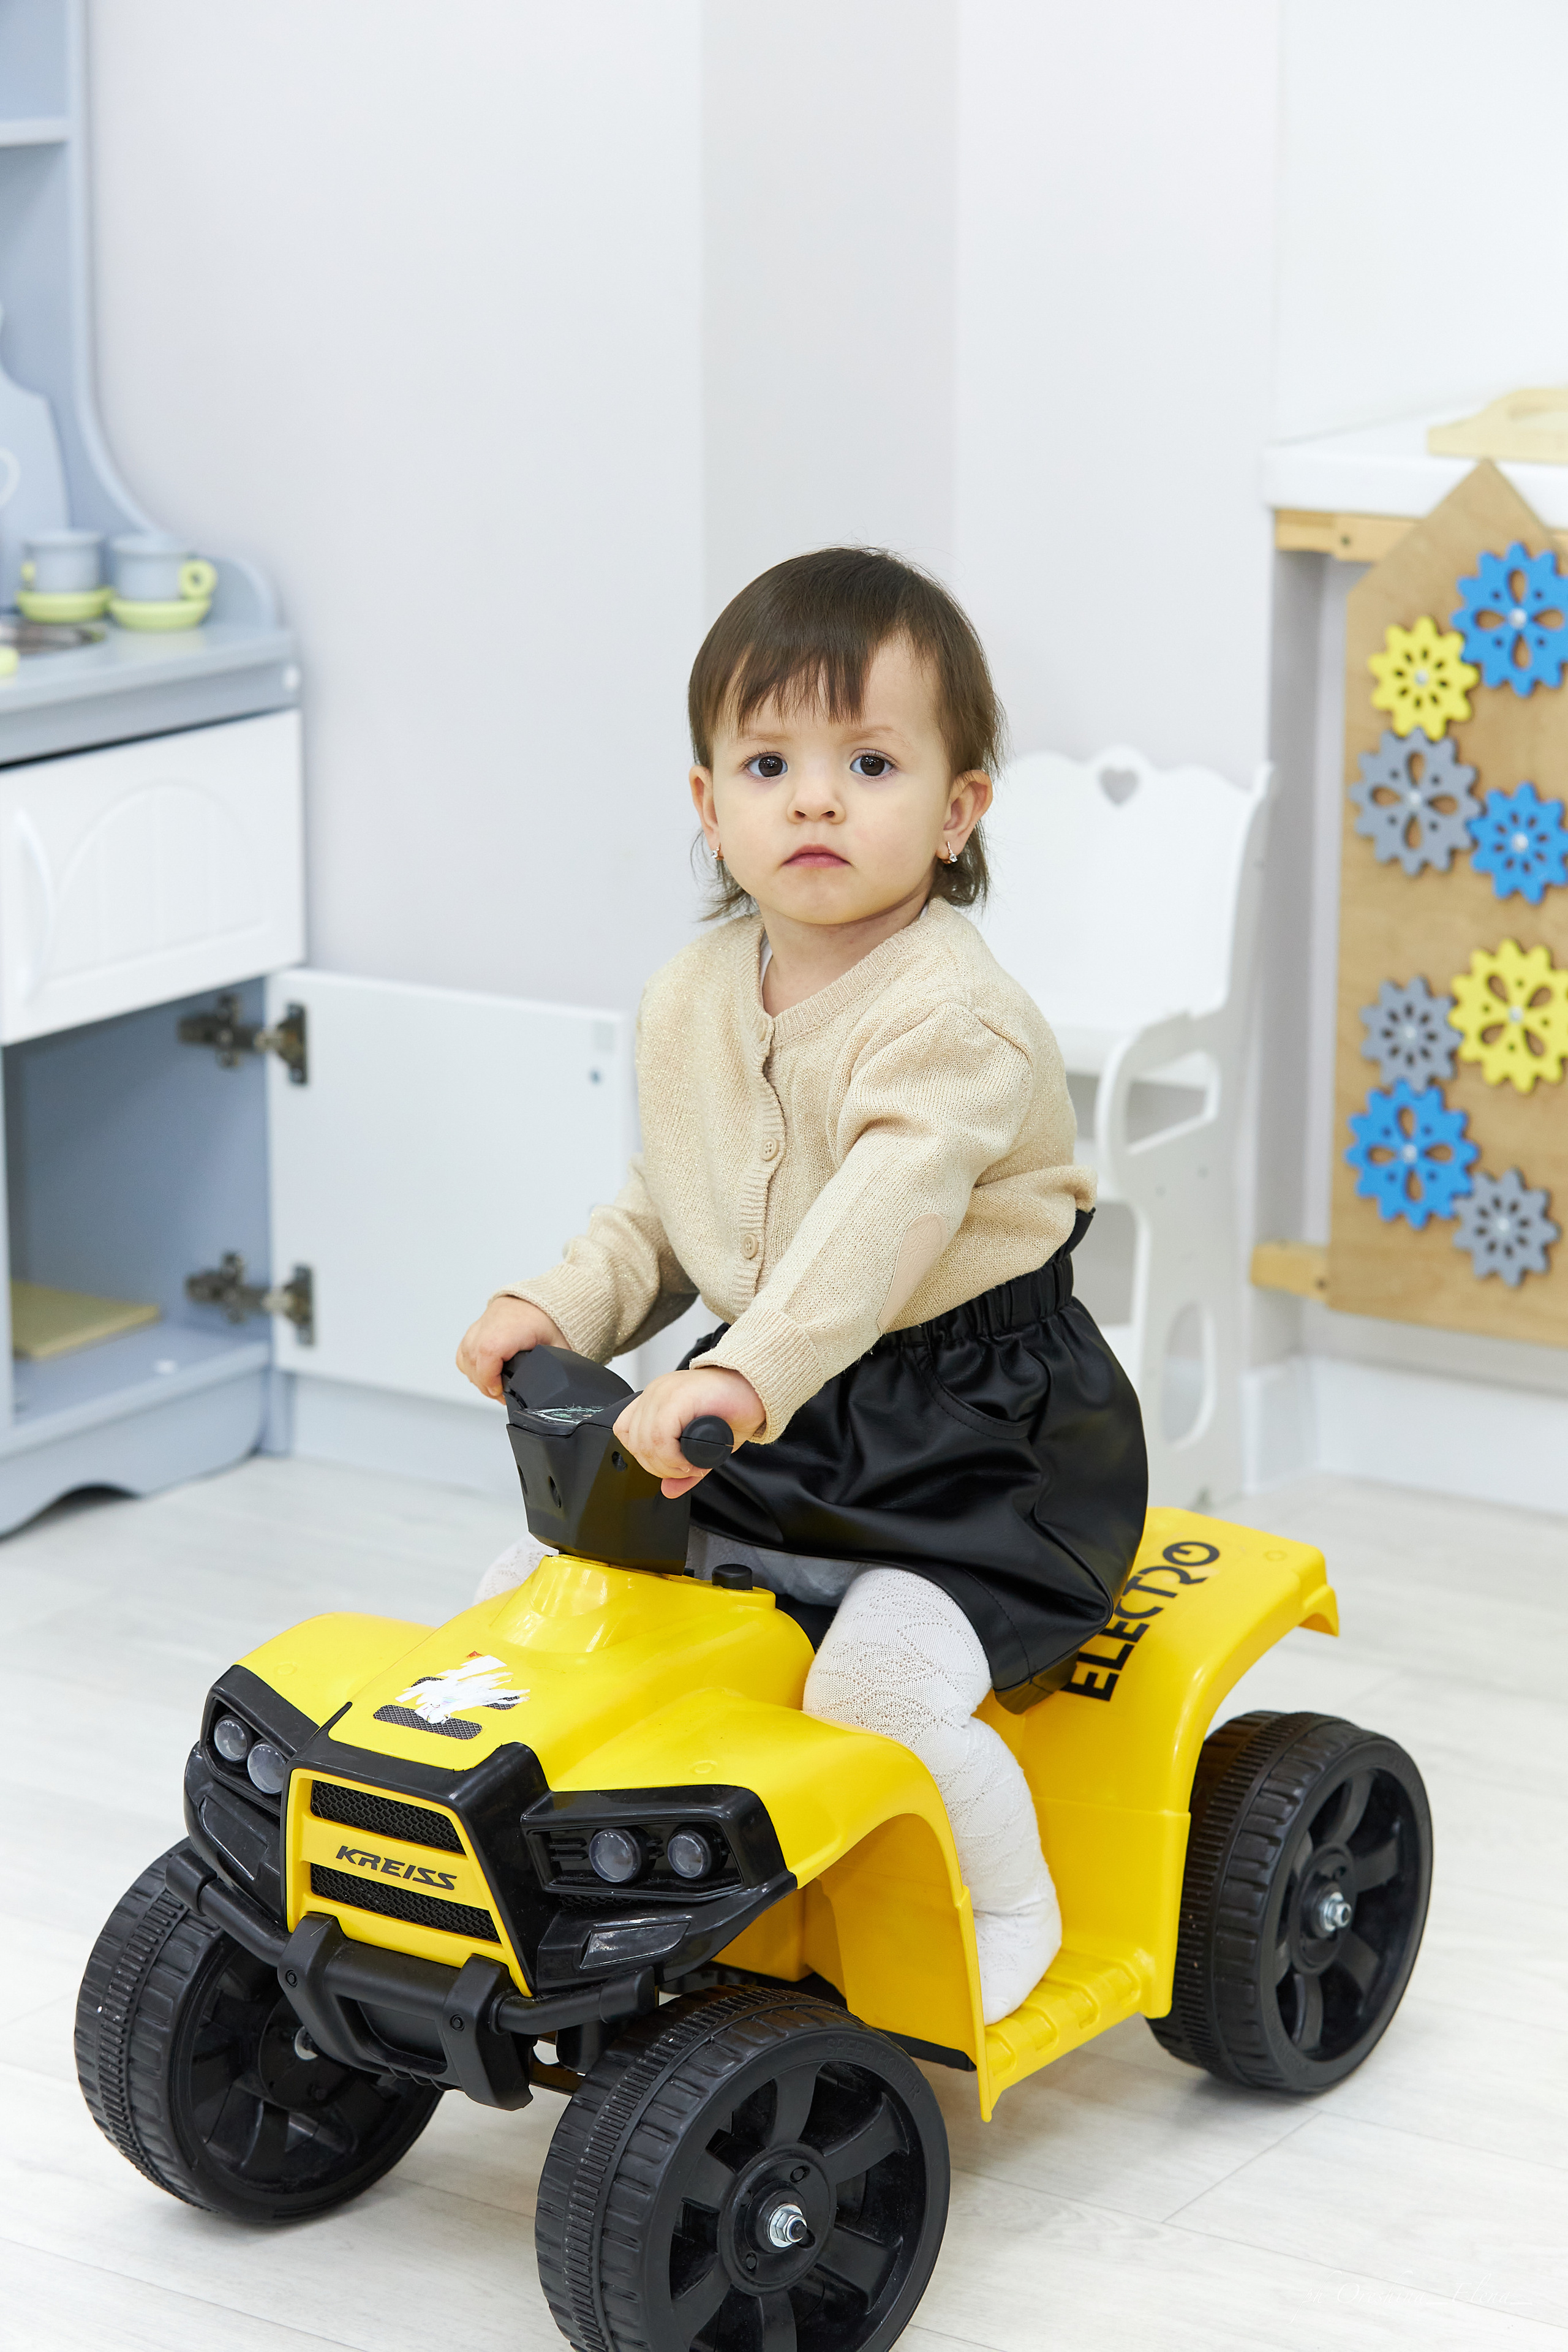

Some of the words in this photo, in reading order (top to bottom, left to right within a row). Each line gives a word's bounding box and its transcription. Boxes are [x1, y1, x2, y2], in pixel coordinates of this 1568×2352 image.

[1060, 1541, 1220, 1702] ELECTRO
[336, 1845, 458, 1890] KREISS
[827, 2037, 876, 2063] SPEED
[876, 2049, 922, 2103] POWER
